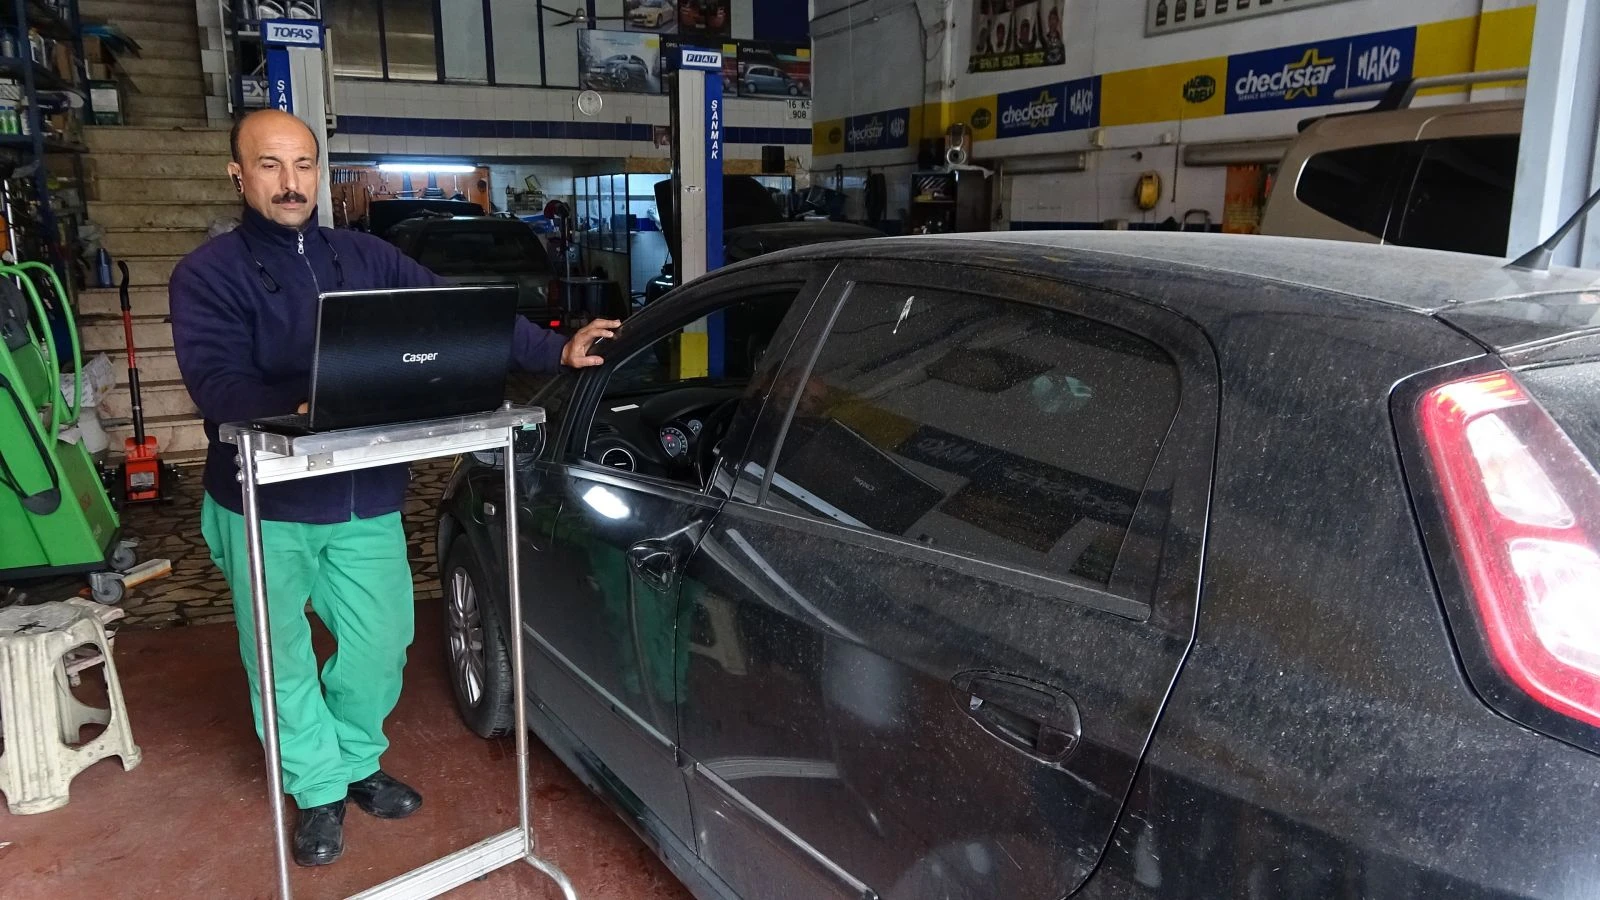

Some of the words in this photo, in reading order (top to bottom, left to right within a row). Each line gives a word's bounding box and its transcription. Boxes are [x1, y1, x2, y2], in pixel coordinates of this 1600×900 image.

[686, 54, 718, 63] FIAT
[1235, 63, 1336, 95] checkstar
[792, 110, 806, 119] 908
[1002, 102, 1058, 124] checkstar
[402, 352, 438, 364] Casper
